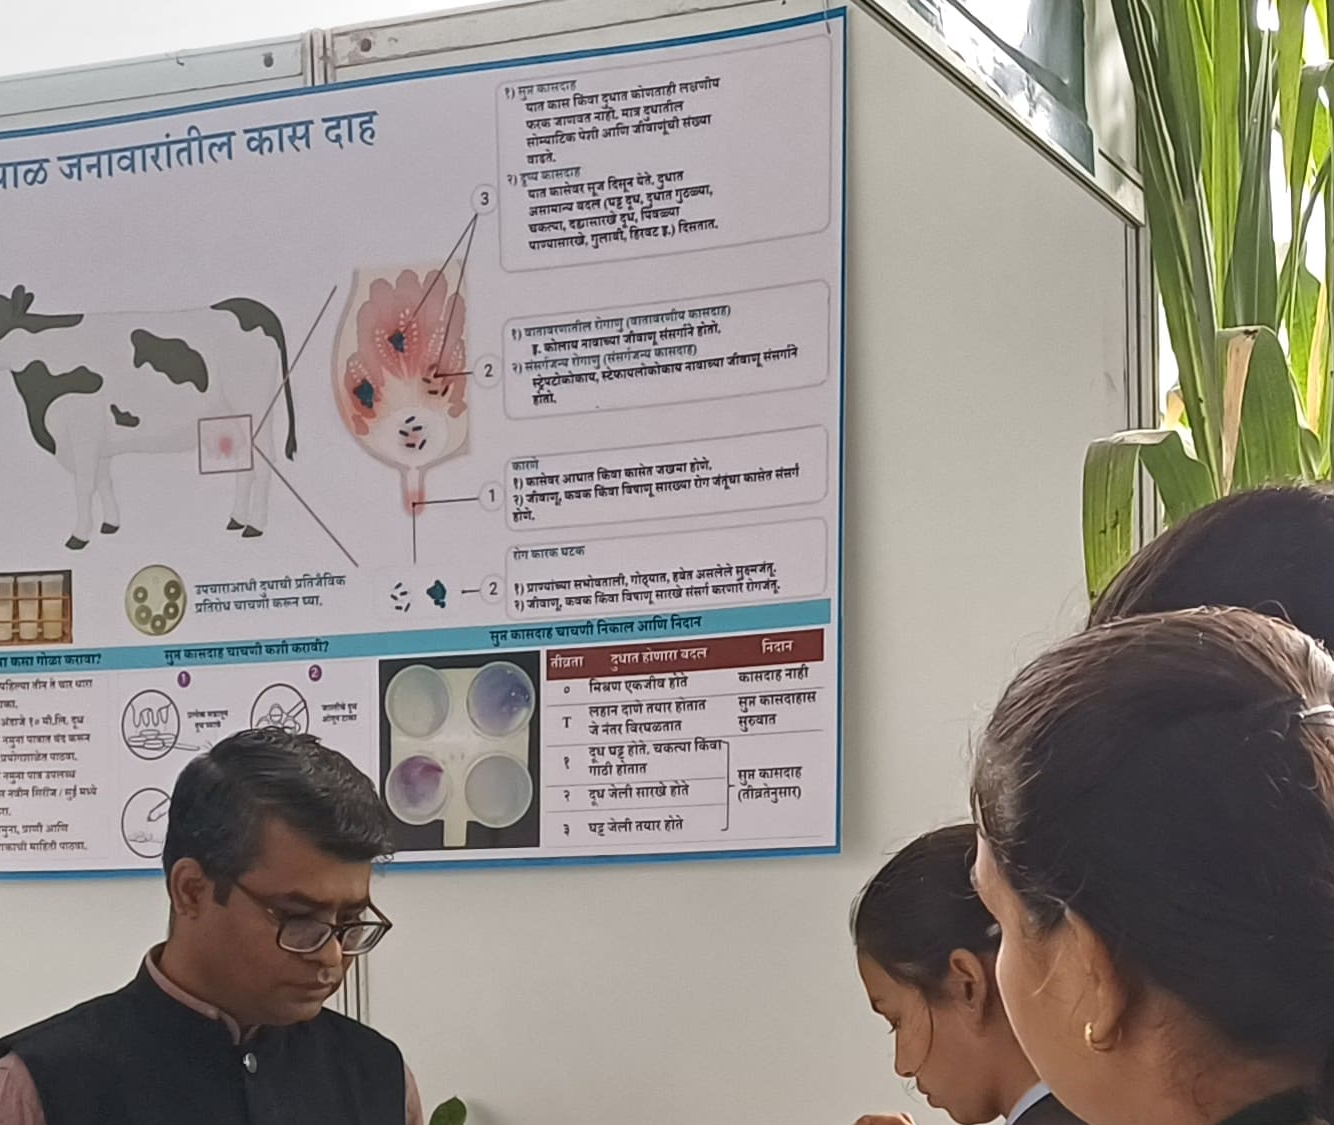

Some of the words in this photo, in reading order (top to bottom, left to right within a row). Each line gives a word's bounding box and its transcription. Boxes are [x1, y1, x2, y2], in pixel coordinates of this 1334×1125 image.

[57, 126, 236, 181] जनावारांतील
[243, 120, 314, 155] कास
[321, 111, 378, 149] दाह
[481, 192, 489, 206] 3
[485, 364, 493, 377] 2
[489, 489, 494, 502] 1
[489, 582, 497, 595] 2
[510, 627, 553, 639] कासदाह
[597, 619, 635, 634] निकाल
[638, 616, 668, 631] आणि
[671, 614, 702, 629] निदान
[762, 638, 793, 653] निदान
[183, 648, 224, 658] कासदाह
[611, 653, 639, 671] दुधात
[642, 650, 678, 663] होणारा
[680, 648, 707, 659] बदल
[551, 654, 583, 668] तीव्रता
[738, 669, 782, 682] कासदाह
[785, 664, 809, 680] नाही
[625, 673, 667, 690] एकजीव
[667, 671, 691, 688] होते
[759, 692, 817, 705] कासदाहास
[589, 705, 618, 717] लहान
[621, 700, 643, 716] दाणे
[646, 702, 672, 713] तयार
[675, 698, 706, 713] होतात
[563, 717, 571, 728] T
[589, 722, 599, 735] जे
[601, 722, 623, 734] नंतर
[589, 746, 605, 763] दूध
[589, 762, 613, 776] गाठी
[616, 761, 647, 776] होतात
[758, 766, 802, 778] कासदाह
[588, 789, 605, 806] दूध
[608, 785, 633, 798] जेली
[635, 783, 667, 797] सारखे
[669, 782, 689, 796] होते
[563, 824, 569, 836] ३
[607, 818, 633, 832] जेली
[635, 820, 661, 831] तयार
[664, 815, 683, 831] होते
